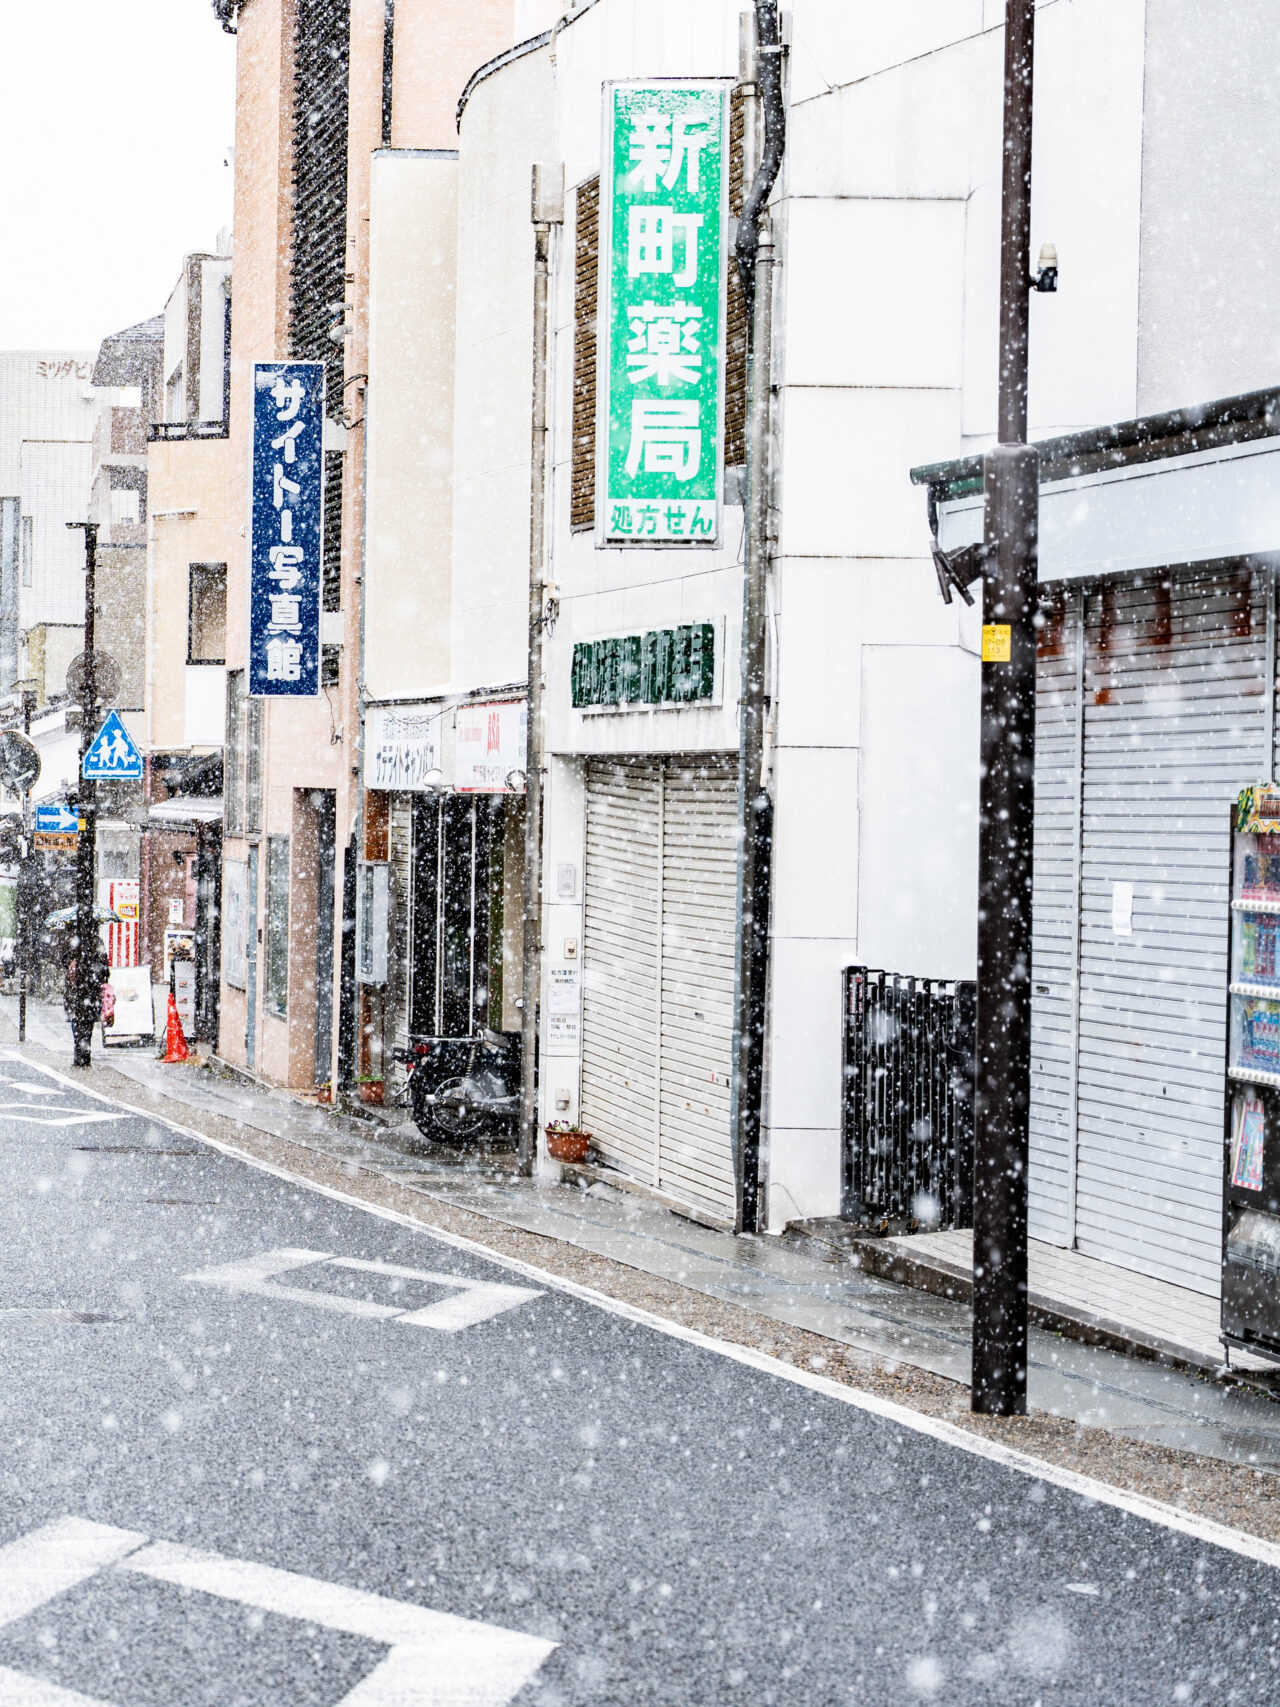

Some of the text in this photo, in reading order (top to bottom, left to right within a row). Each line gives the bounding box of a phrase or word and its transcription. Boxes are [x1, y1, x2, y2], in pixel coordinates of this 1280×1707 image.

[624, 110, 705, 482] 新町薬局
[266, 378, 306, 681] サイトー写真館
[610, 503, 714, 536] 処方せん
